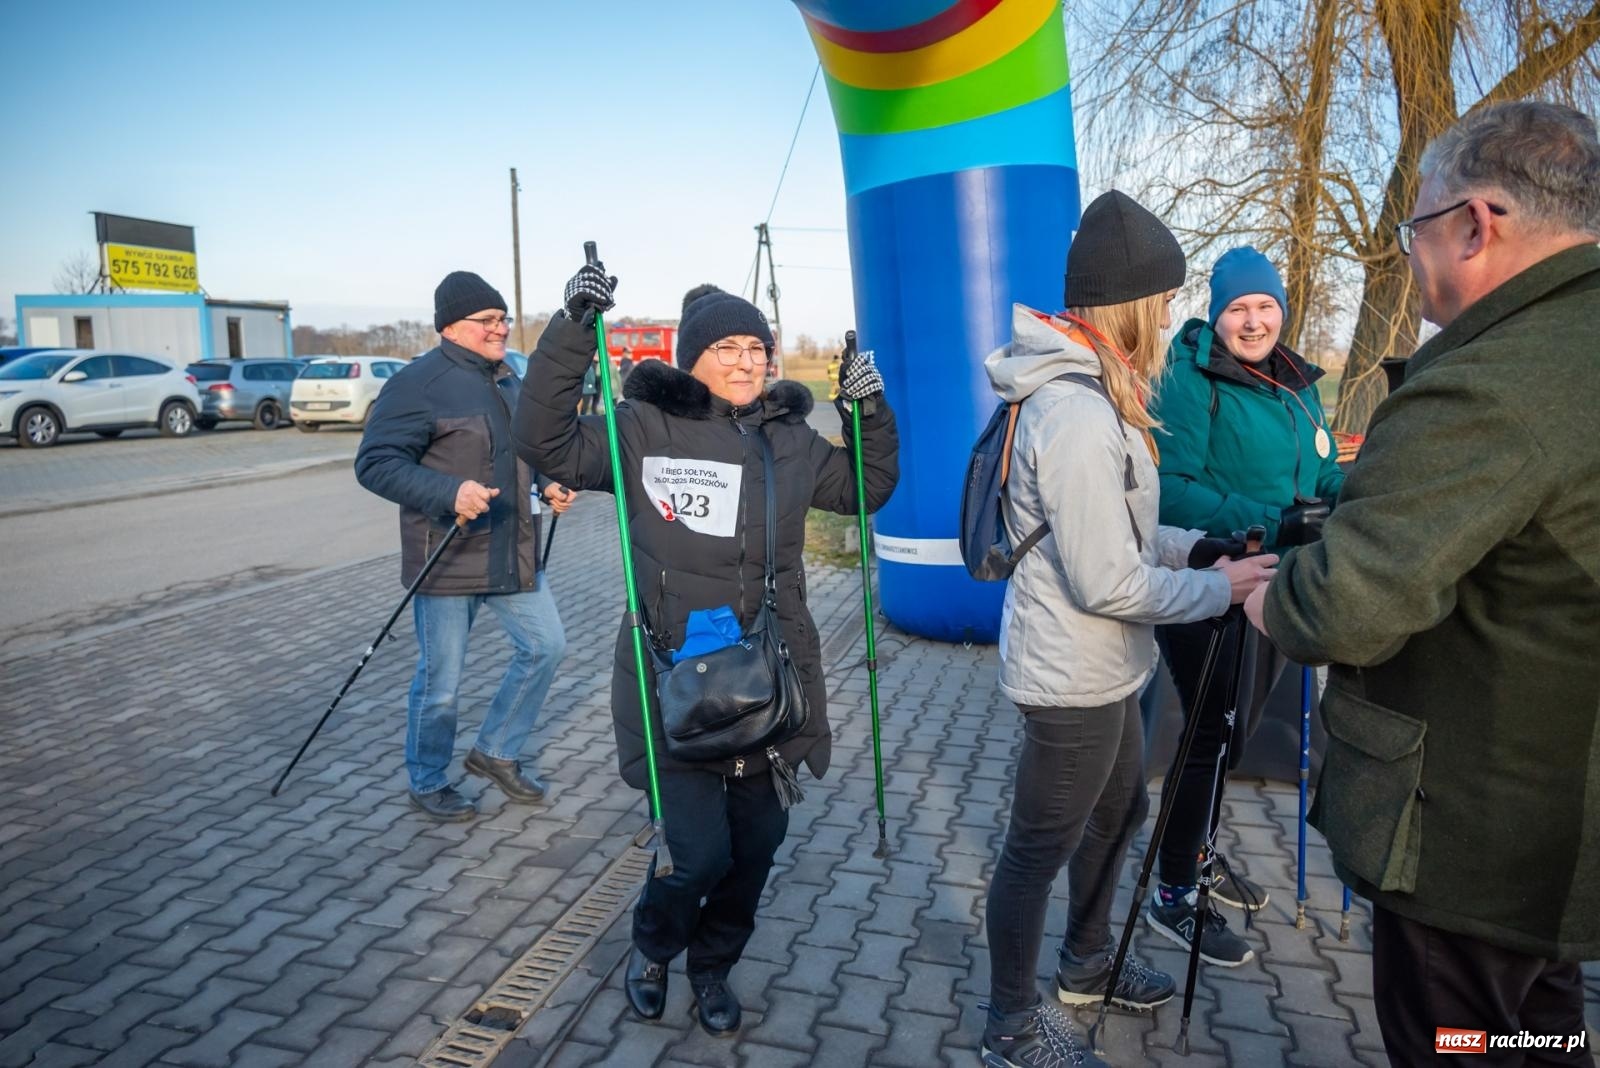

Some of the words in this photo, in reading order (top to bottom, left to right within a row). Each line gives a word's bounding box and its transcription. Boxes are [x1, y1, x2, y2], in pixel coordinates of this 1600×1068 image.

[112, 258, 140, 275] 575
[144, 262, 169, 278] 792
[173, 265, 196, 280] 626
[684, 468, 717, 478] SOŁTYSA
[689, 478, 728, 488] ROSZKÓW
[670, 492, 710, 518] 123
